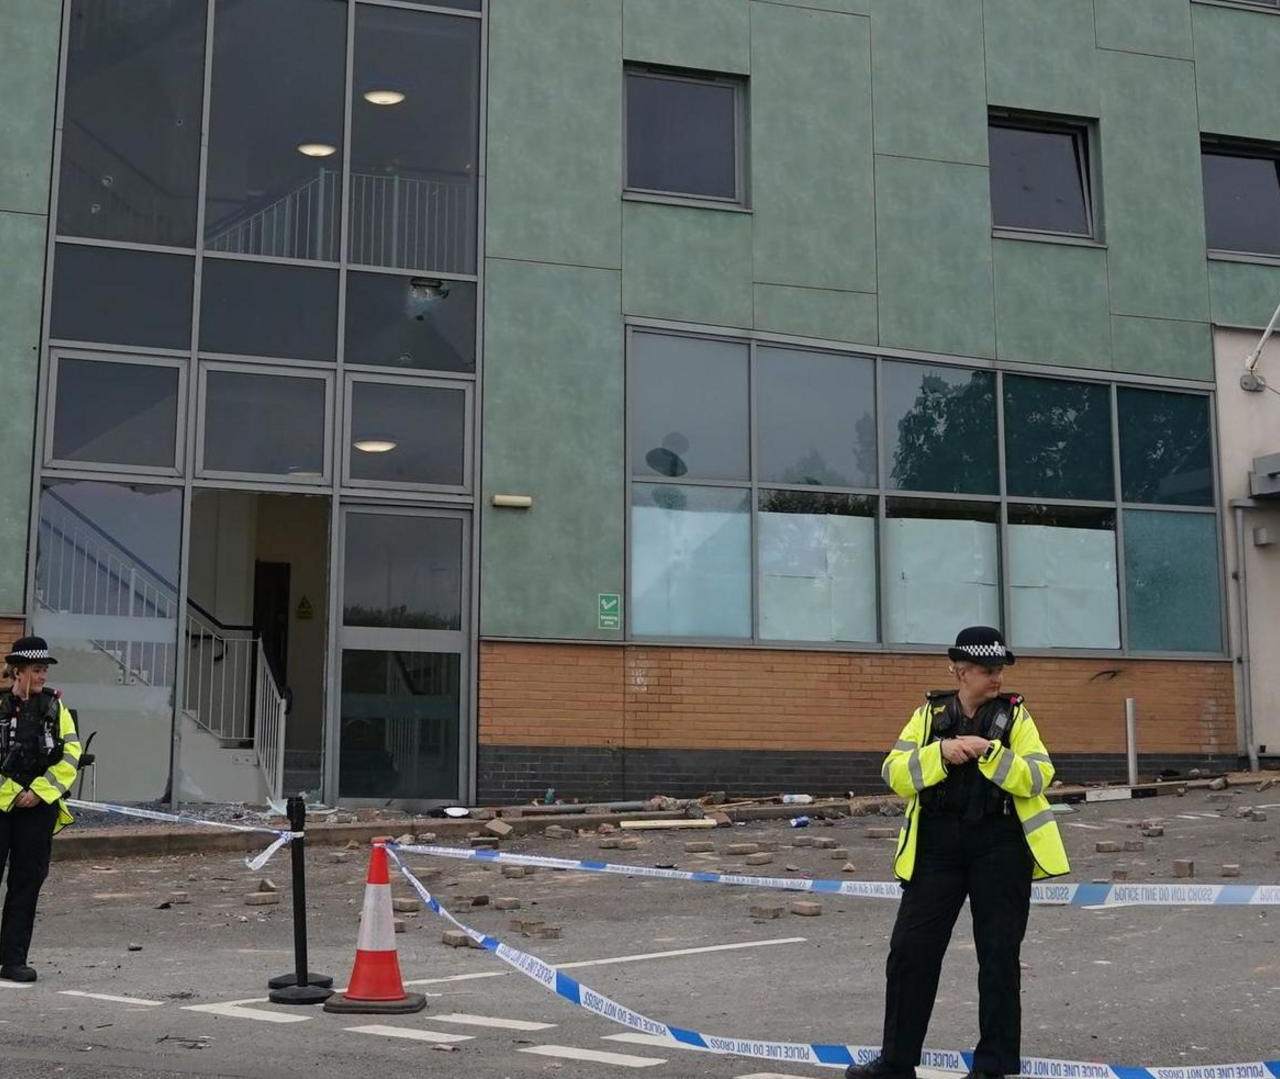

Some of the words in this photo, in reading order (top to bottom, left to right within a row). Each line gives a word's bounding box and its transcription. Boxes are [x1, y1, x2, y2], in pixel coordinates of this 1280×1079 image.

[583, 991, 604, 1011] CROSS
[604, 1001, 617, 1017] NOT
[616, 1008, 627, 1022] DO
[627, 1012, 642, 1028] LINE
[643, 1018, 667, 1036] POLICE
[710, 1038, 735, 1052] CROSS
[736, 1042, 751, 1054] NOT
[753, 1044, 764, 1055] DO
[766, 1044, 782, 1058] LINE
[784, 1046, 809, 1060] POLICE
[932, 1053, 959, 1069] POLICE
[1033, 1060, 1049, 1076] NOT
[1050, 1061, 1061, 1077] DO
[1063, 1063, 1079, 1078] LINE
[1081, 1065, 1109, 1078] POLICE
[1158, 1069, 1184, 1079] CROSS
[1186, 1068, 1202, 1079] NOT
[1204, 1067, 1216, 1079] DO
[1217, 1067, 1234, 1079] LINE
[1236, 1065, 1264, 1079] POLICE
